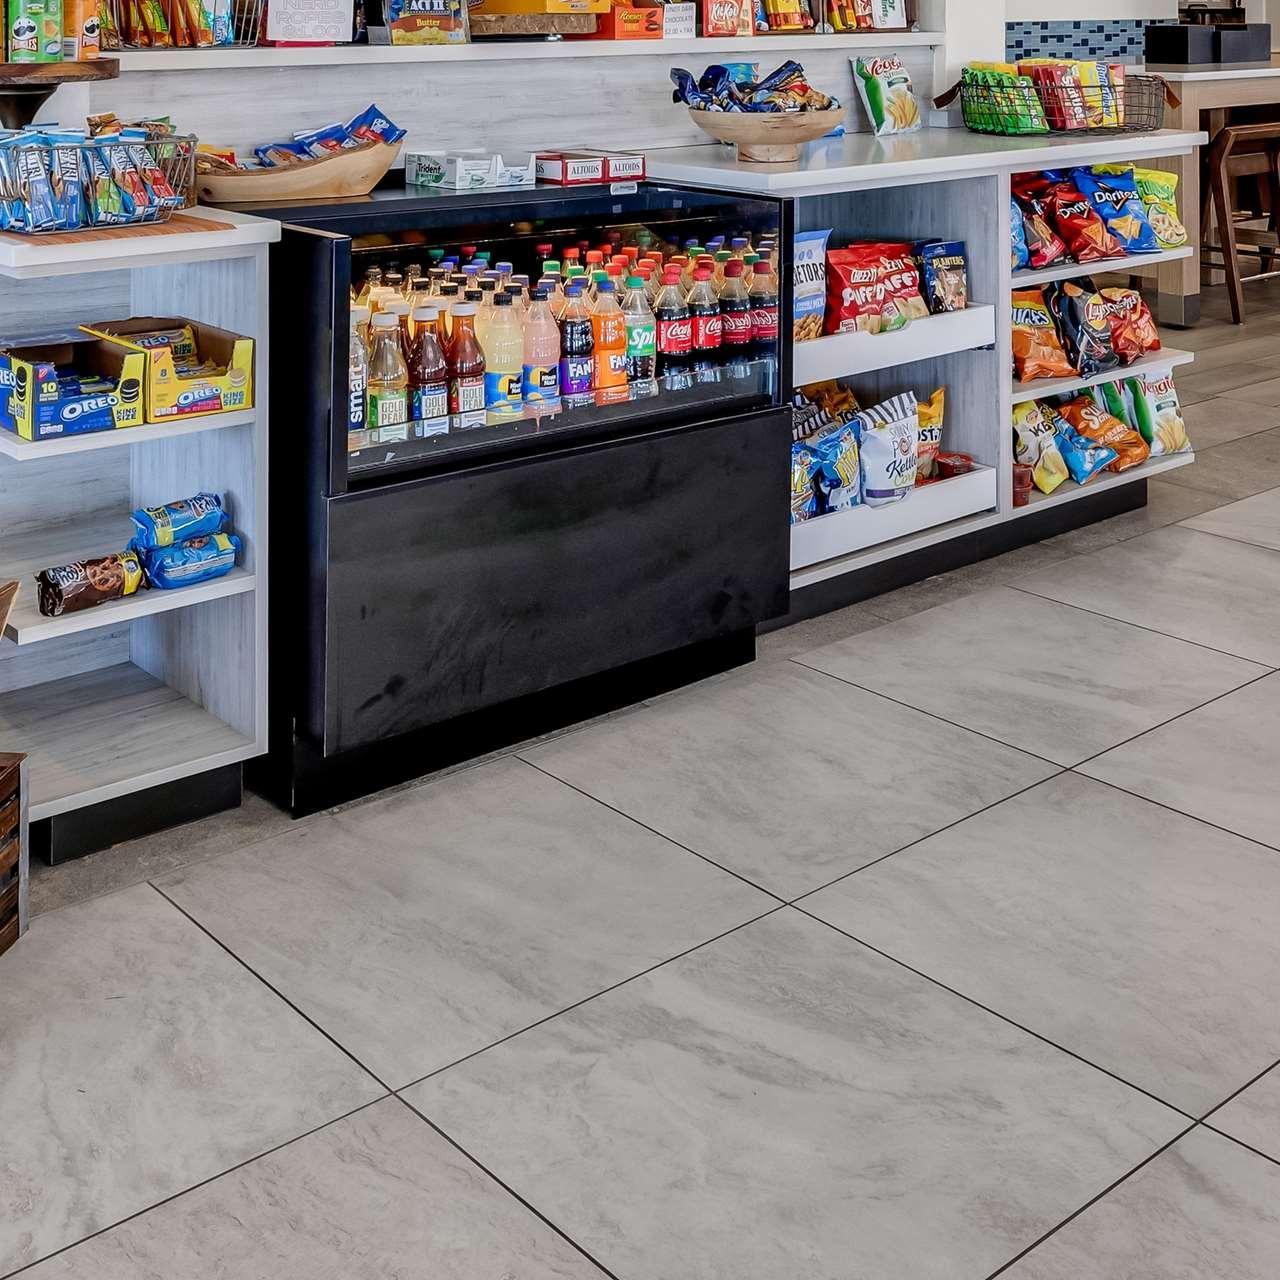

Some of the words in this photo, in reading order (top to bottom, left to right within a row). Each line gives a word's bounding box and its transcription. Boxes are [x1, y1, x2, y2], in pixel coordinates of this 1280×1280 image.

[417, 162, 442, 175] Trident
[571, 164, 601, 176] ALTOIDS
[613, 162, 641, 174] ALTOIDS
[932, 255, 965, 269] PLANTERS
[41, 381, 57, 394] 10
[177, 387, 222, 407] OREO
[350, 365, 363, 424] smart
[61, 395, 119, 421] OREO
